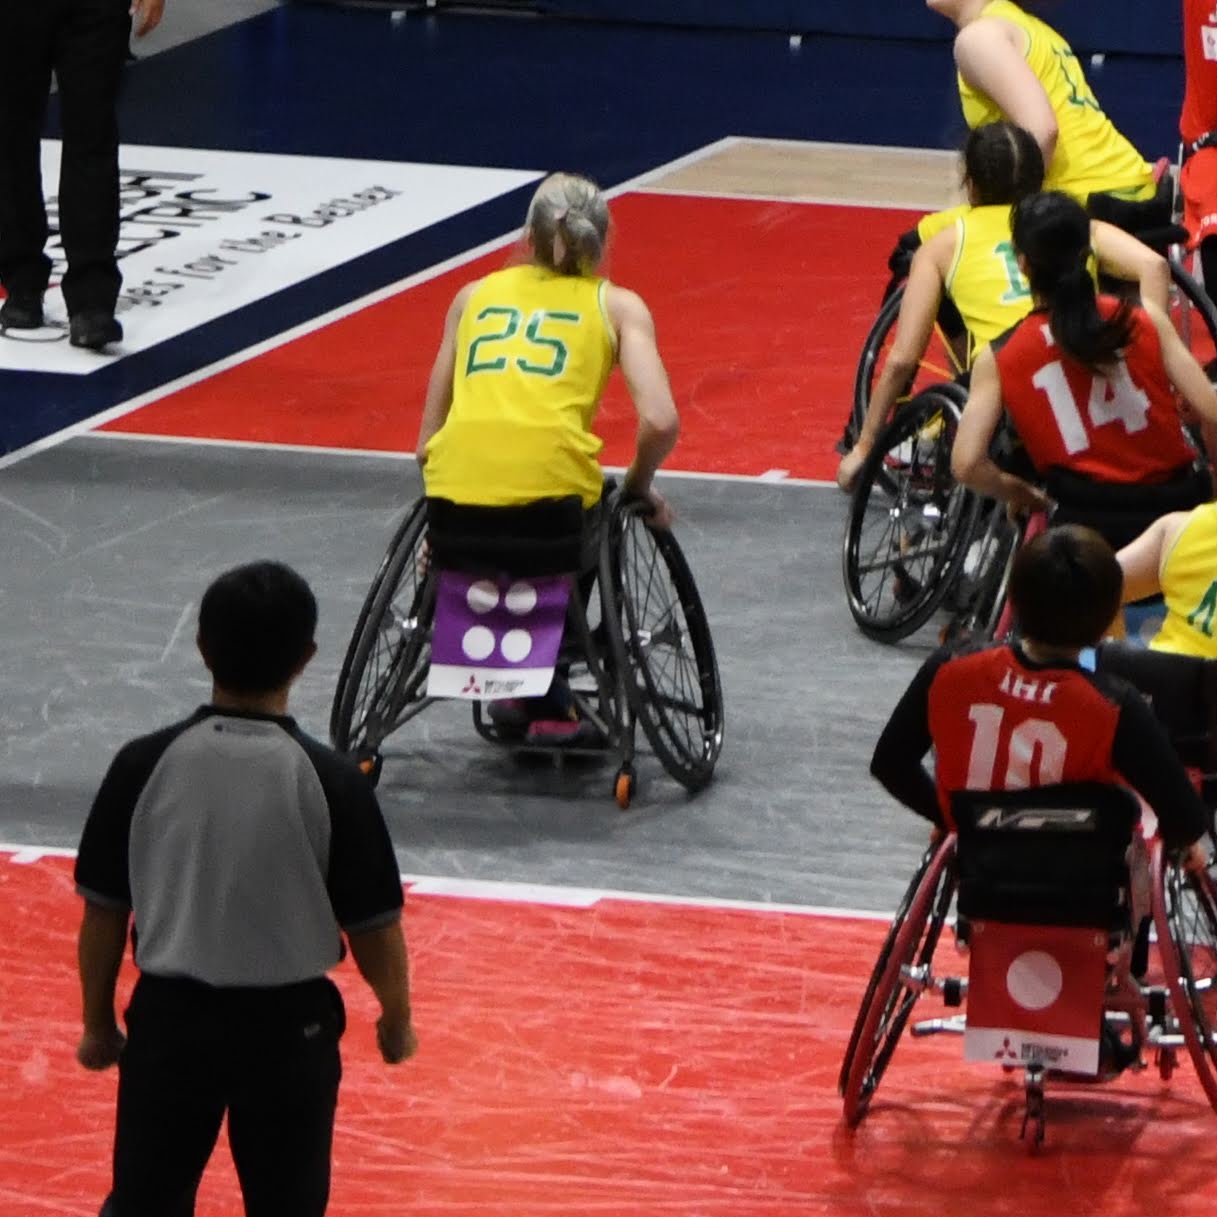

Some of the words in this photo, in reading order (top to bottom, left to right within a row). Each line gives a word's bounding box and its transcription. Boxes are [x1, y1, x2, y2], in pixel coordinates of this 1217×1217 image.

[466, 307, 580, 377] 25
[1032, 360, 1151, 455] 14
[966, 703, 1067, 790] 10
